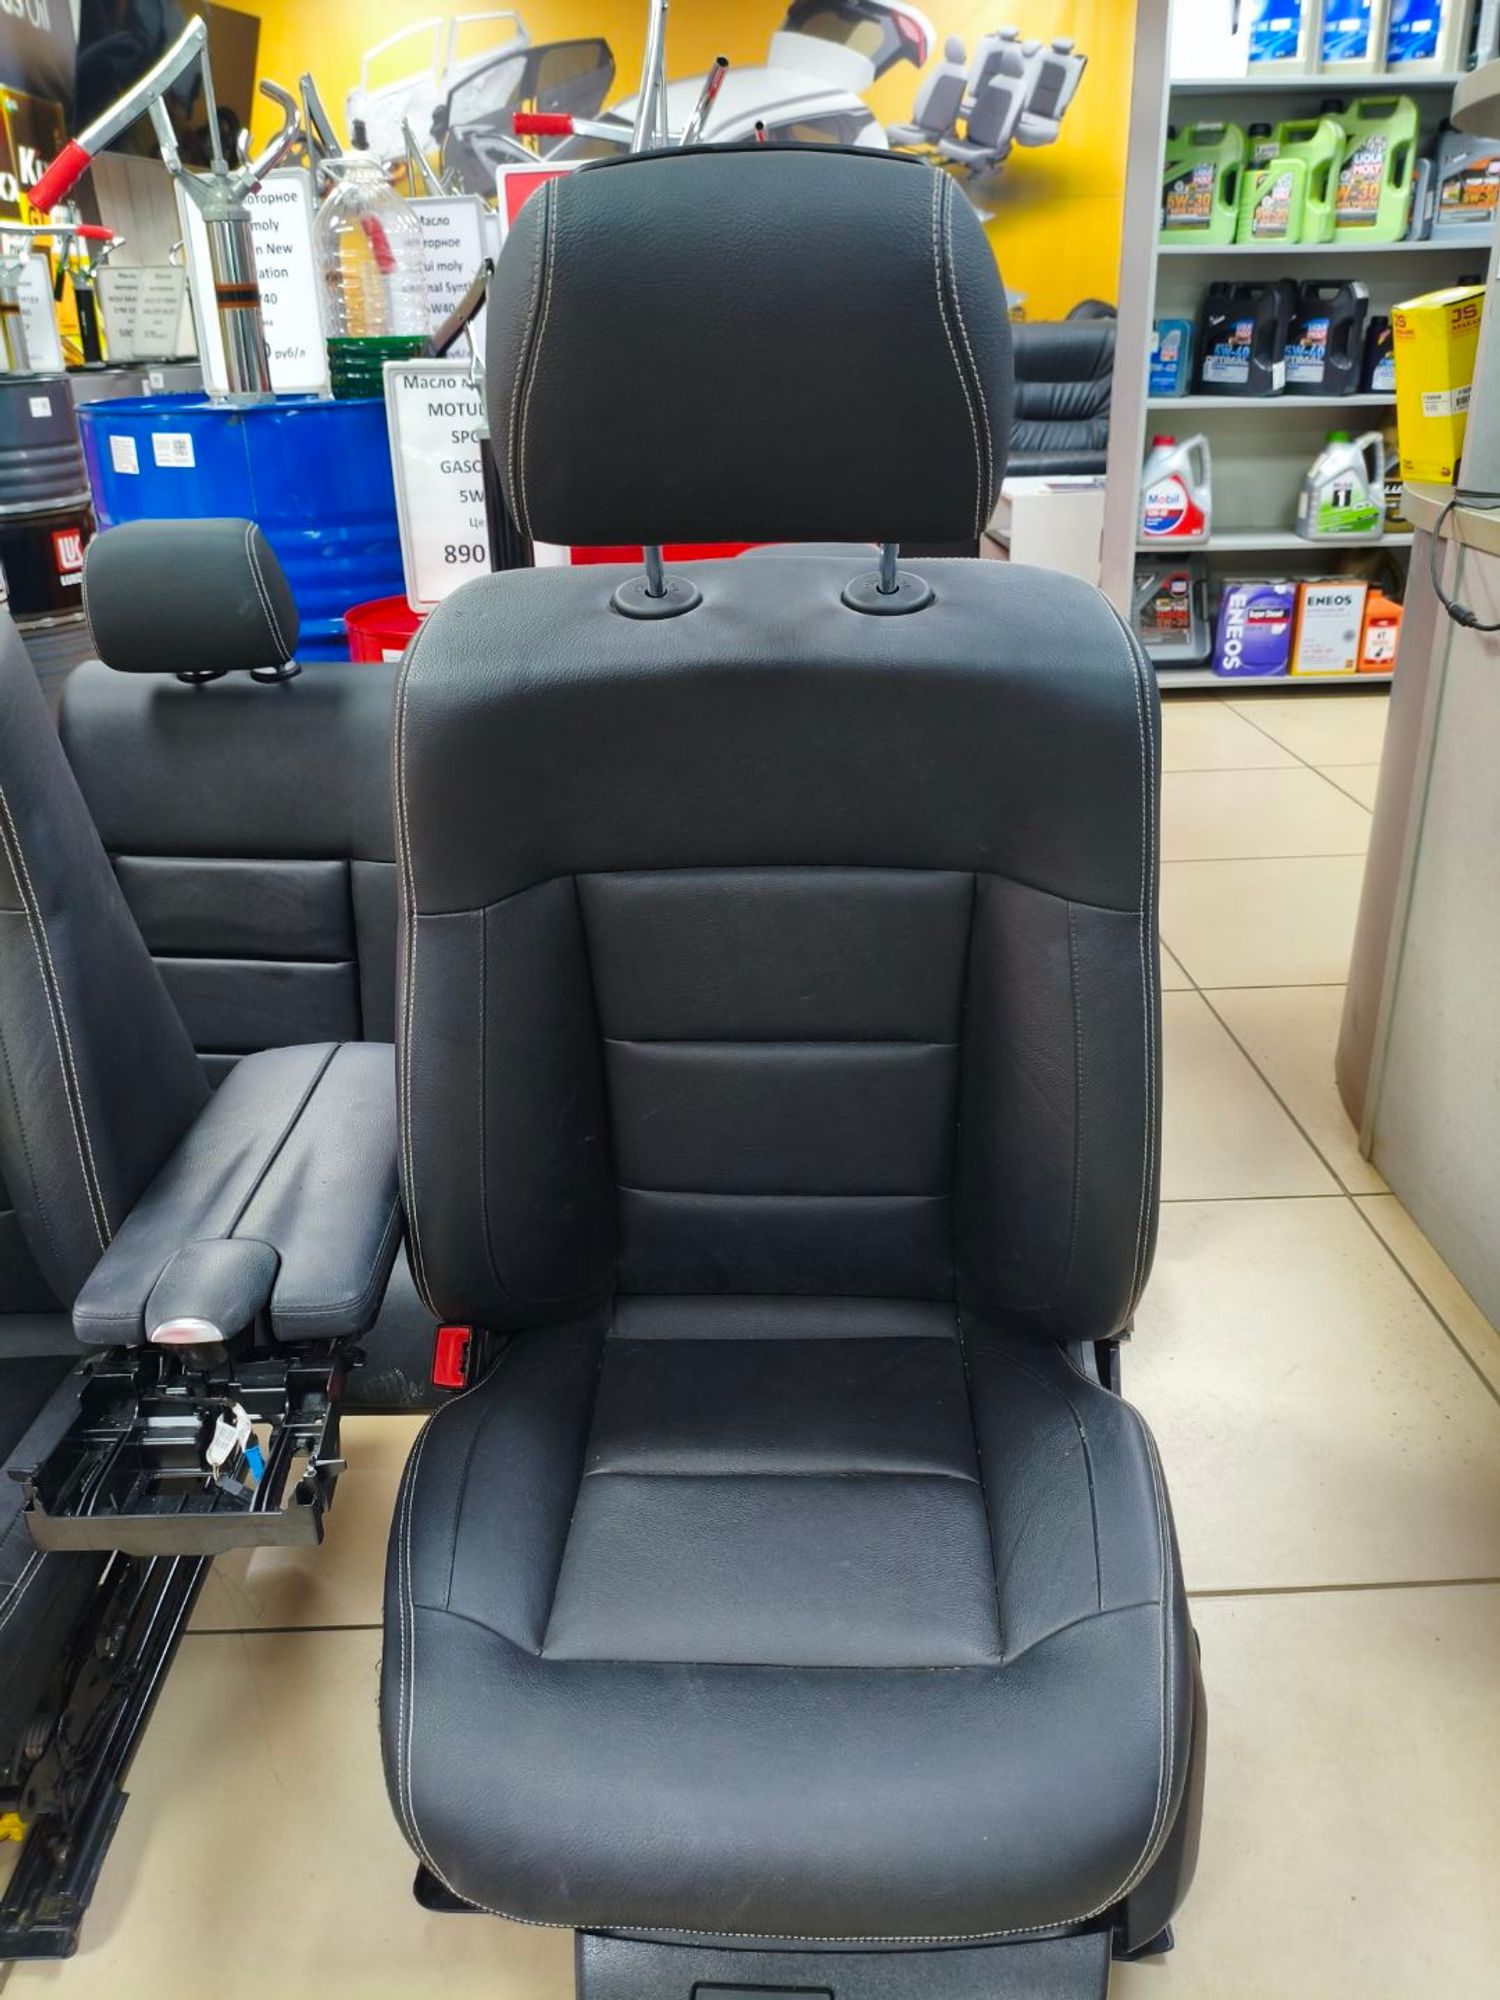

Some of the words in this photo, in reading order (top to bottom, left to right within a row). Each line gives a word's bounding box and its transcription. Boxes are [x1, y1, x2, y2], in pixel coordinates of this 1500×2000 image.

[245, 192, 298, 205] оторное
[266, 243, 293, 254] New
[259, 267, 289, 279] ation
[264, 293, 278, 305] 40
[1452, 304, 1478, 324] JS
[403, 375, 457, 389] Масло
[459, 490, 484, 503] 5W
[1148, 494, 1180, 504] Mobil
[469, 517, 484, 528] Це
[444, 544, 485, 564] 890
[1307, 595, 1352, 606] ENEOS
[1222, 594, 1247, 670] ENEOS
